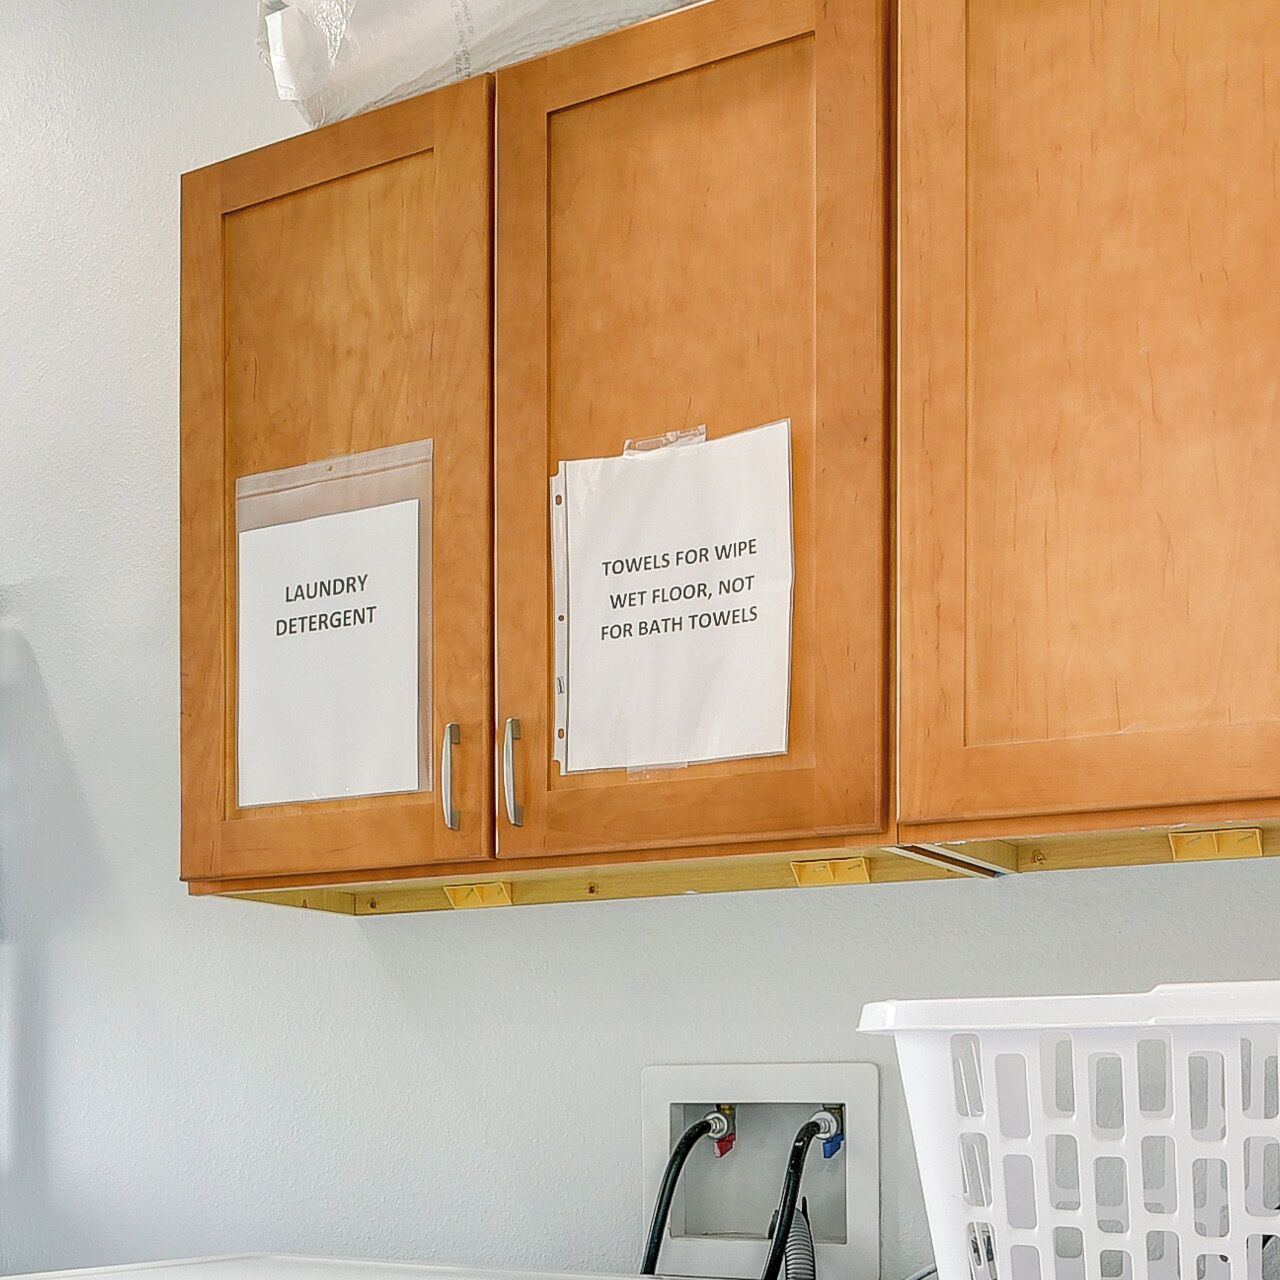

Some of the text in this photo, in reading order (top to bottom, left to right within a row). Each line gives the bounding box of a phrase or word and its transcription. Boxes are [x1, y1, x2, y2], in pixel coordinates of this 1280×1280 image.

[601, 538, 758, 576] TOWELS FOR WIPE
[285, 573, 368, 603] LAUNDRY
[609, 575, 755, 609] WET FLOOR, NOT
[276, 605, 377, 636] DETERGENT
[600, 605, 758, 641] FOR BATH TOWELS
